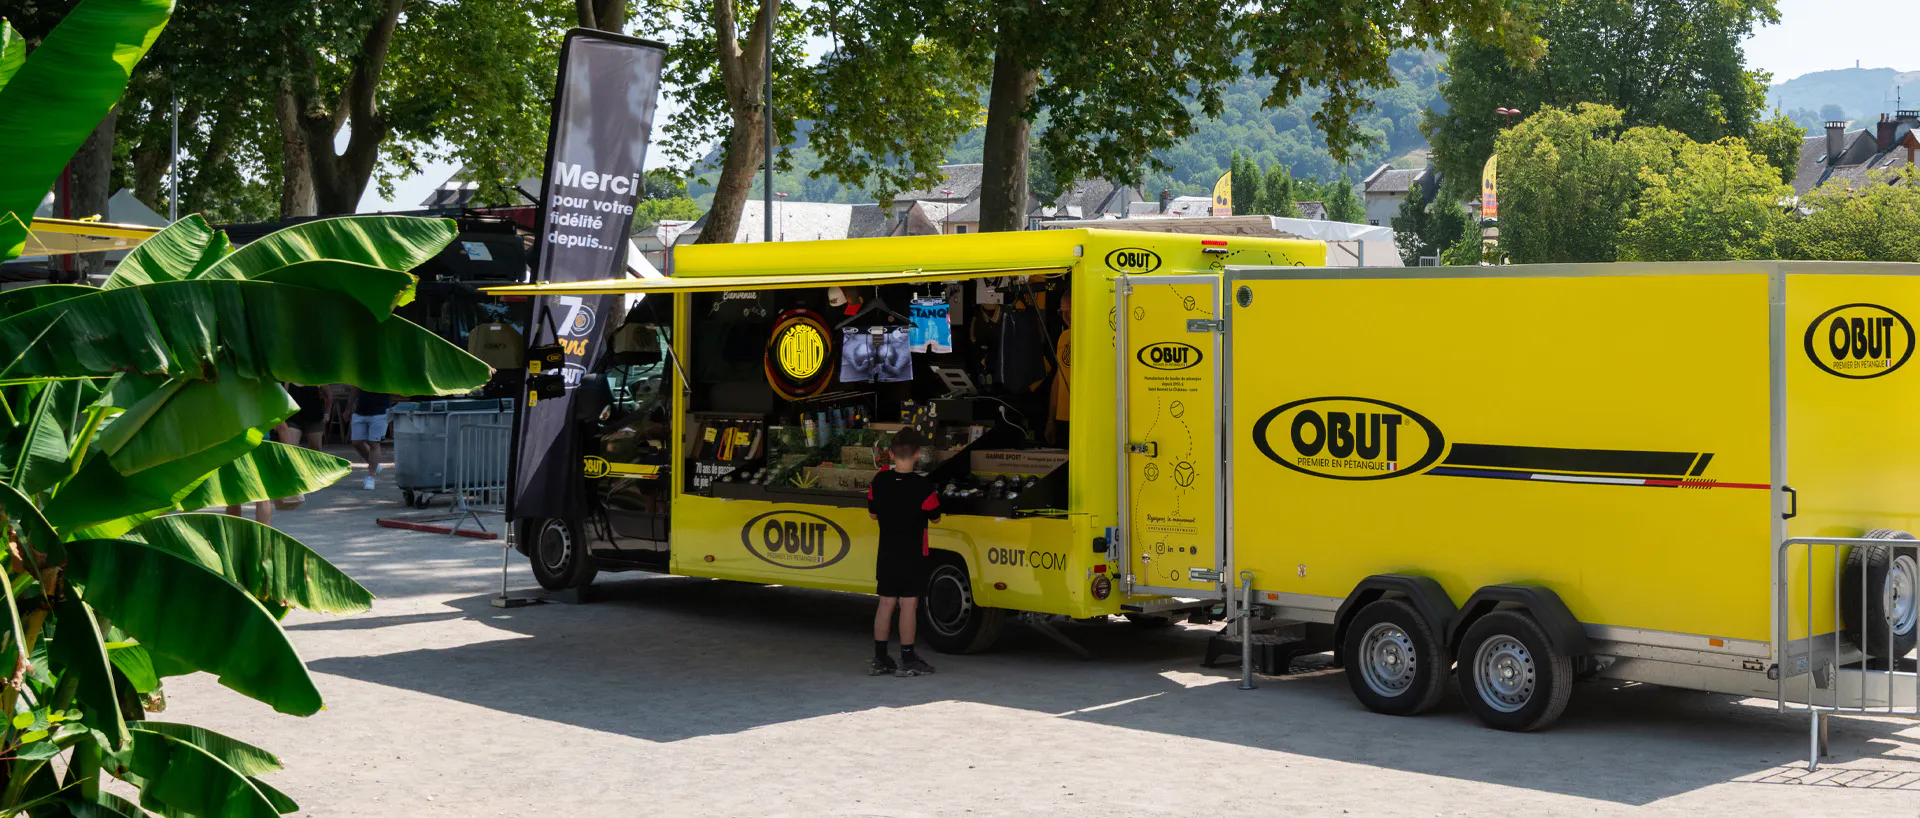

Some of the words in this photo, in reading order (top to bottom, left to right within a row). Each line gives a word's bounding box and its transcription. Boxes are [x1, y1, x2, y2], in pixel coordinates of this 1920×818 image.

[555, 161, 639, 196] Merci
[552, 194, 589, 208] pour
[593, 200, 634, 216] votre
[550, 212, 602, 230] fidélité
[548, 231, 613, 250] depuis...
[1117, 252, 1150, 268] OBUT
[557, 296, 596, 336] 70
[1829, 316, 1894, 360] OBUT
[1150, 346, 1189, 364] OBUT
[1291, 410, 1402, 462] OBUT
[1298, 458, 1329, 467] PREMIER
[1332, 459, 1342, 468] EN
[764, 519, 828, 556] OBUT
[988, 547, 1066, 571] OBUT.COM
